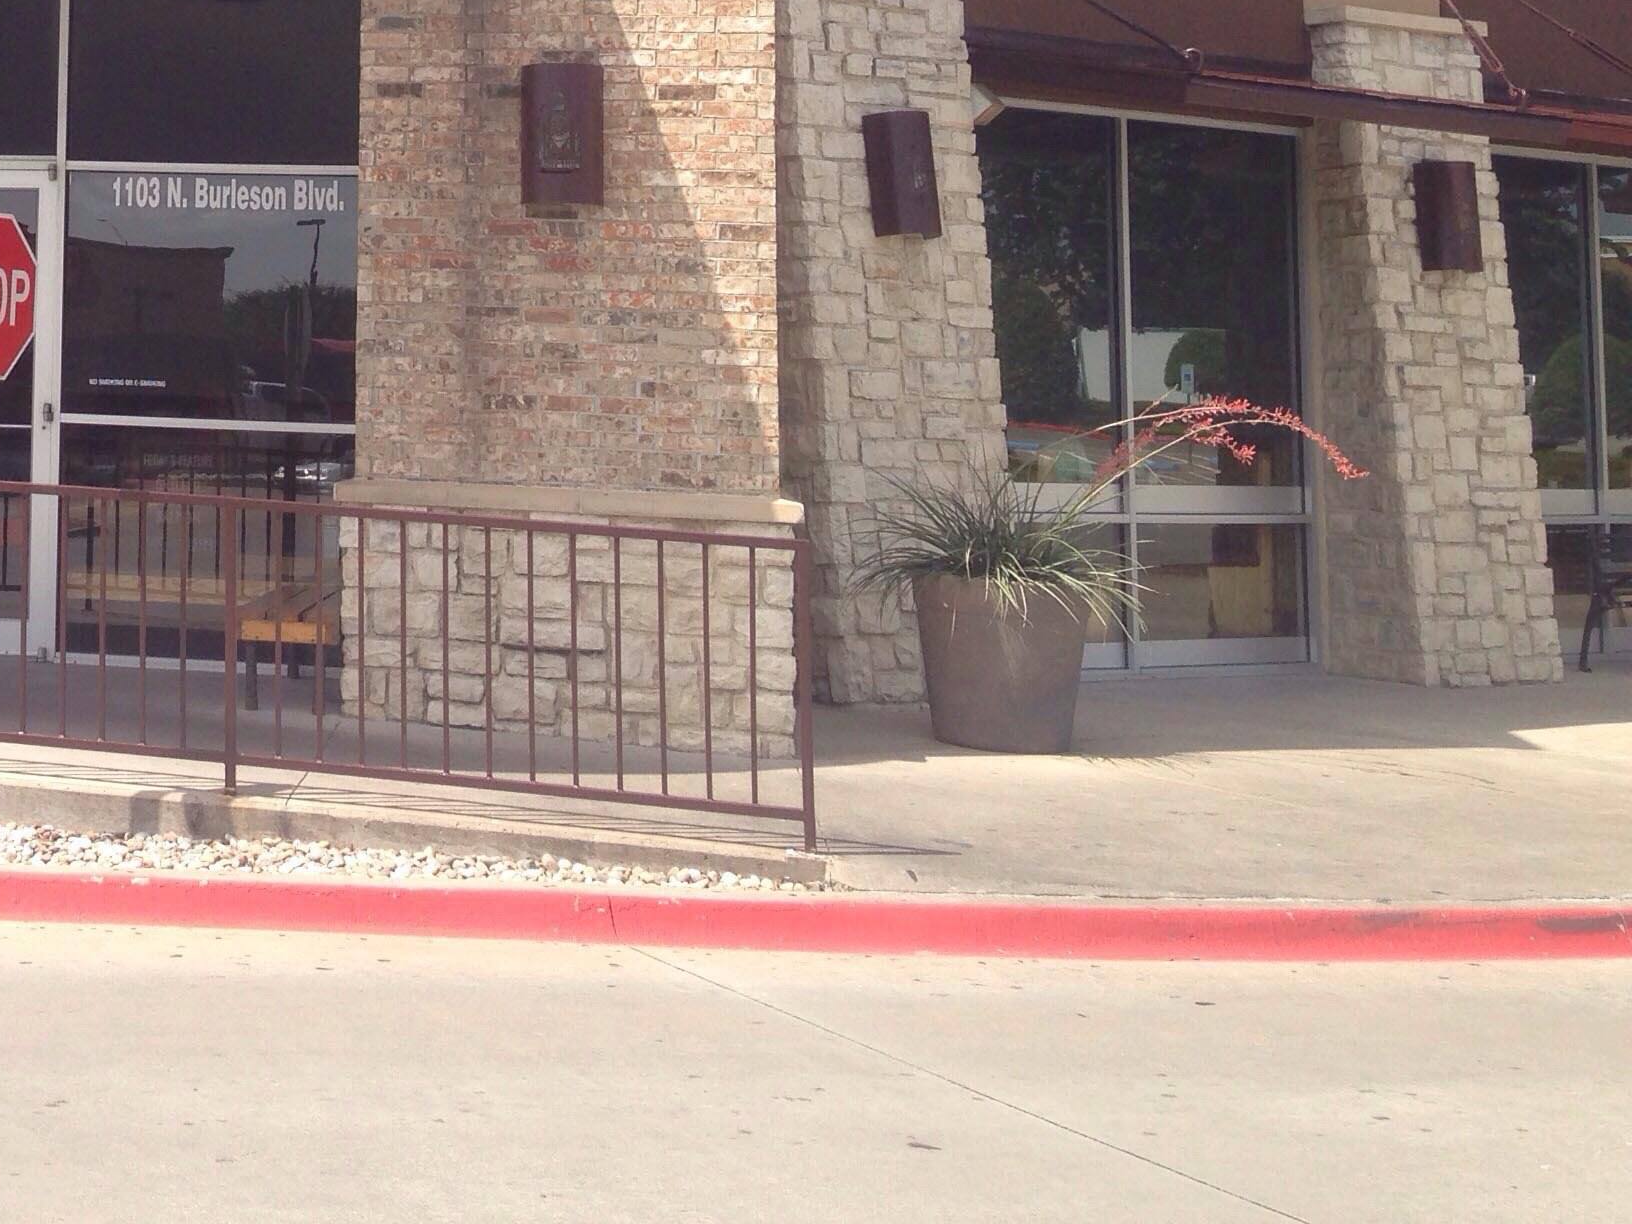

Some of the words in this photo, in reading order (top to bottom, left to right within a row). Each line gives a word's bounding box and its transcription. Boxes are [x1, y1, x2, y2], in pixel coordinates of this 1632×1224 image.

[113, 177, 160, 208] 1103
[167, 177, 187, 208] N.
[195, 178, 286, 209] Burleson
[294, 180, 344, 211] Blvd.
